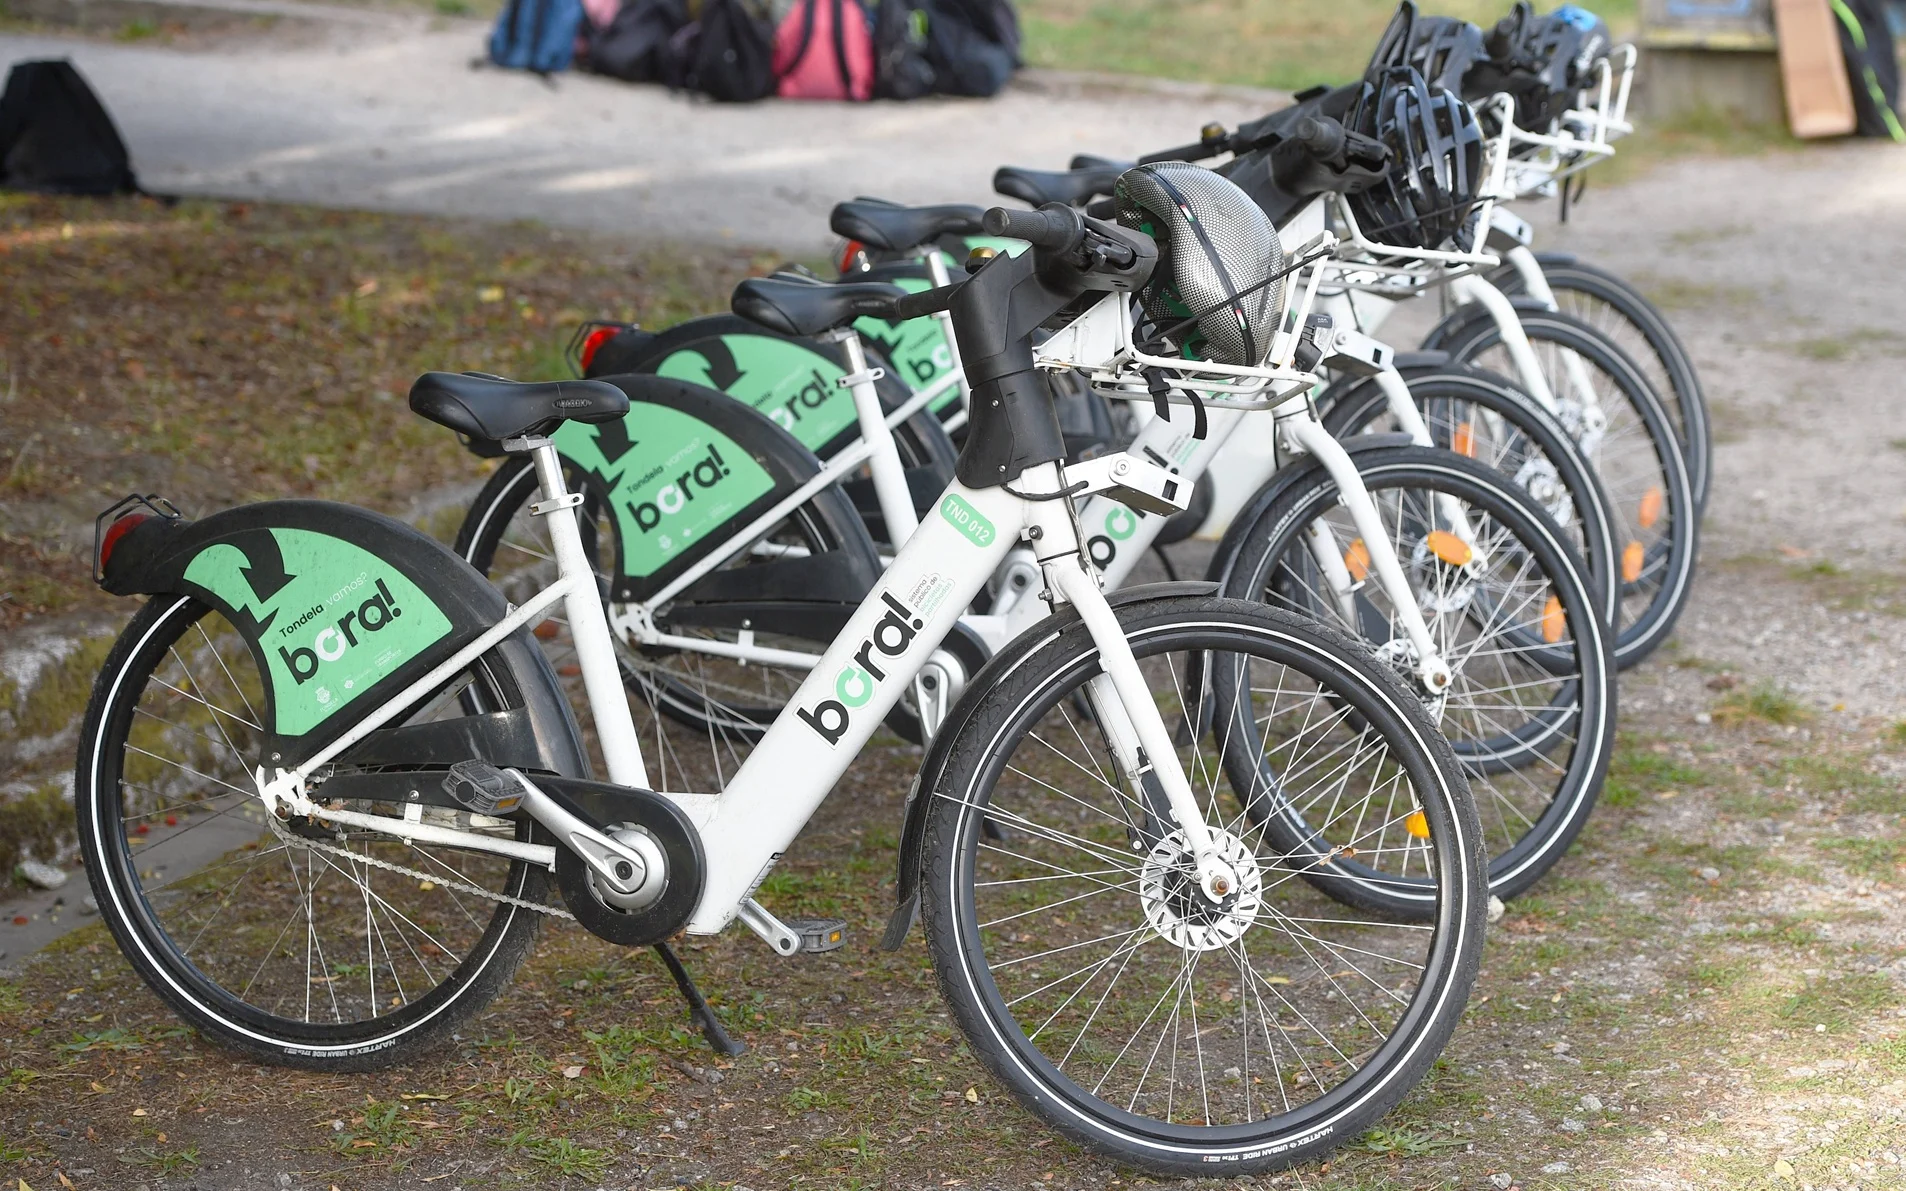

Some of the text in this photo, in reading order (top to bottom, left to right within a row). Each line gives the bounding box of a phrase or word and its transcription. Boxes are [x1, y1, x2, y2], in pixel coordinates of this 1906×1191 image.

[625, 442, 731, 535] bora!
[945, 499, 990, 542] TND 012
[325, 571, 367, 606] vamos?
[908, 578, 927, 603] sistema
[913, 576, 938, 608] público de
[277, 577, 402, 686] bora!
[796, 591, 924, 746] bora!
[312, 1050, 327, 1058] RIDE
[327, 1050, 348, 1058] URBAN
[356, 1038, 396, 1056] HARTEX
[1297, 1125, 1334, 1148] HARTEX
[1242, 1152, 1261, 1160] RIDE
[1261, 1143, 1288, 1157] URBAN
